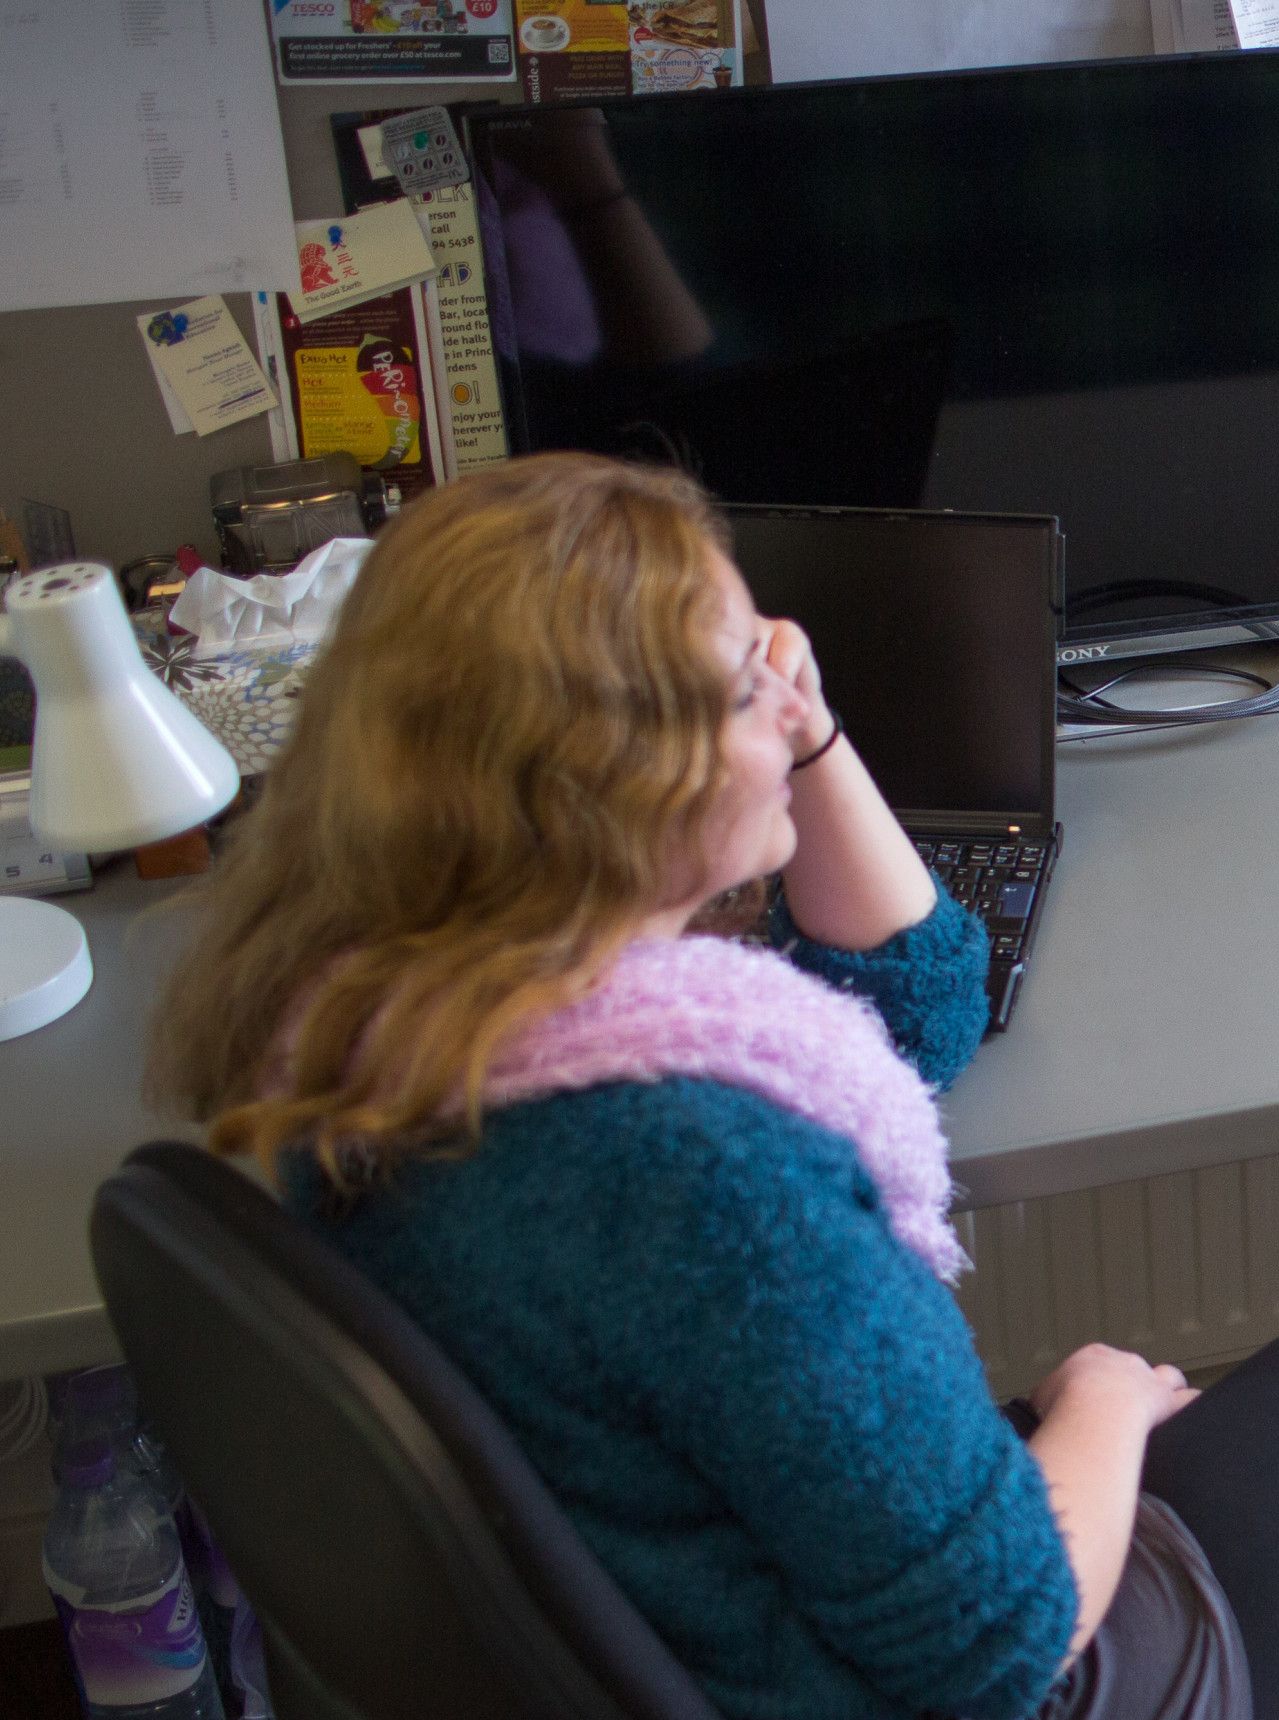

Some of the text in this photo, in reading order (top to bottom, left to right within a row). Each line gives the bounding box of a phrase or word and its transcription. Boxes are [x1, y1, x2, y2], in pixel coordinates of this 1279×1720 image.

[292, 4, 335, 13] TESCO
[472, 2, 492, 12] £10
[424, 43, 441, 51] your
[331, 53, 359, 61] grocery
[400, 51, 413, 59] £50
[636, 58, 713, 69] Try something new!
[488, 120, 533, 129] BRAVIA
[432, 224, 450, 234] call
[432, 236, 475, 249] 94 5438
[320, 288, 340, 299] Good
[341, 281, 362, 292] Earth
[462, 334, 487, 344] halls
[301, 353, 347, 364] Extra Hot
[453, 350, 462, 358] in
[455, 438, 479, 448] like!
